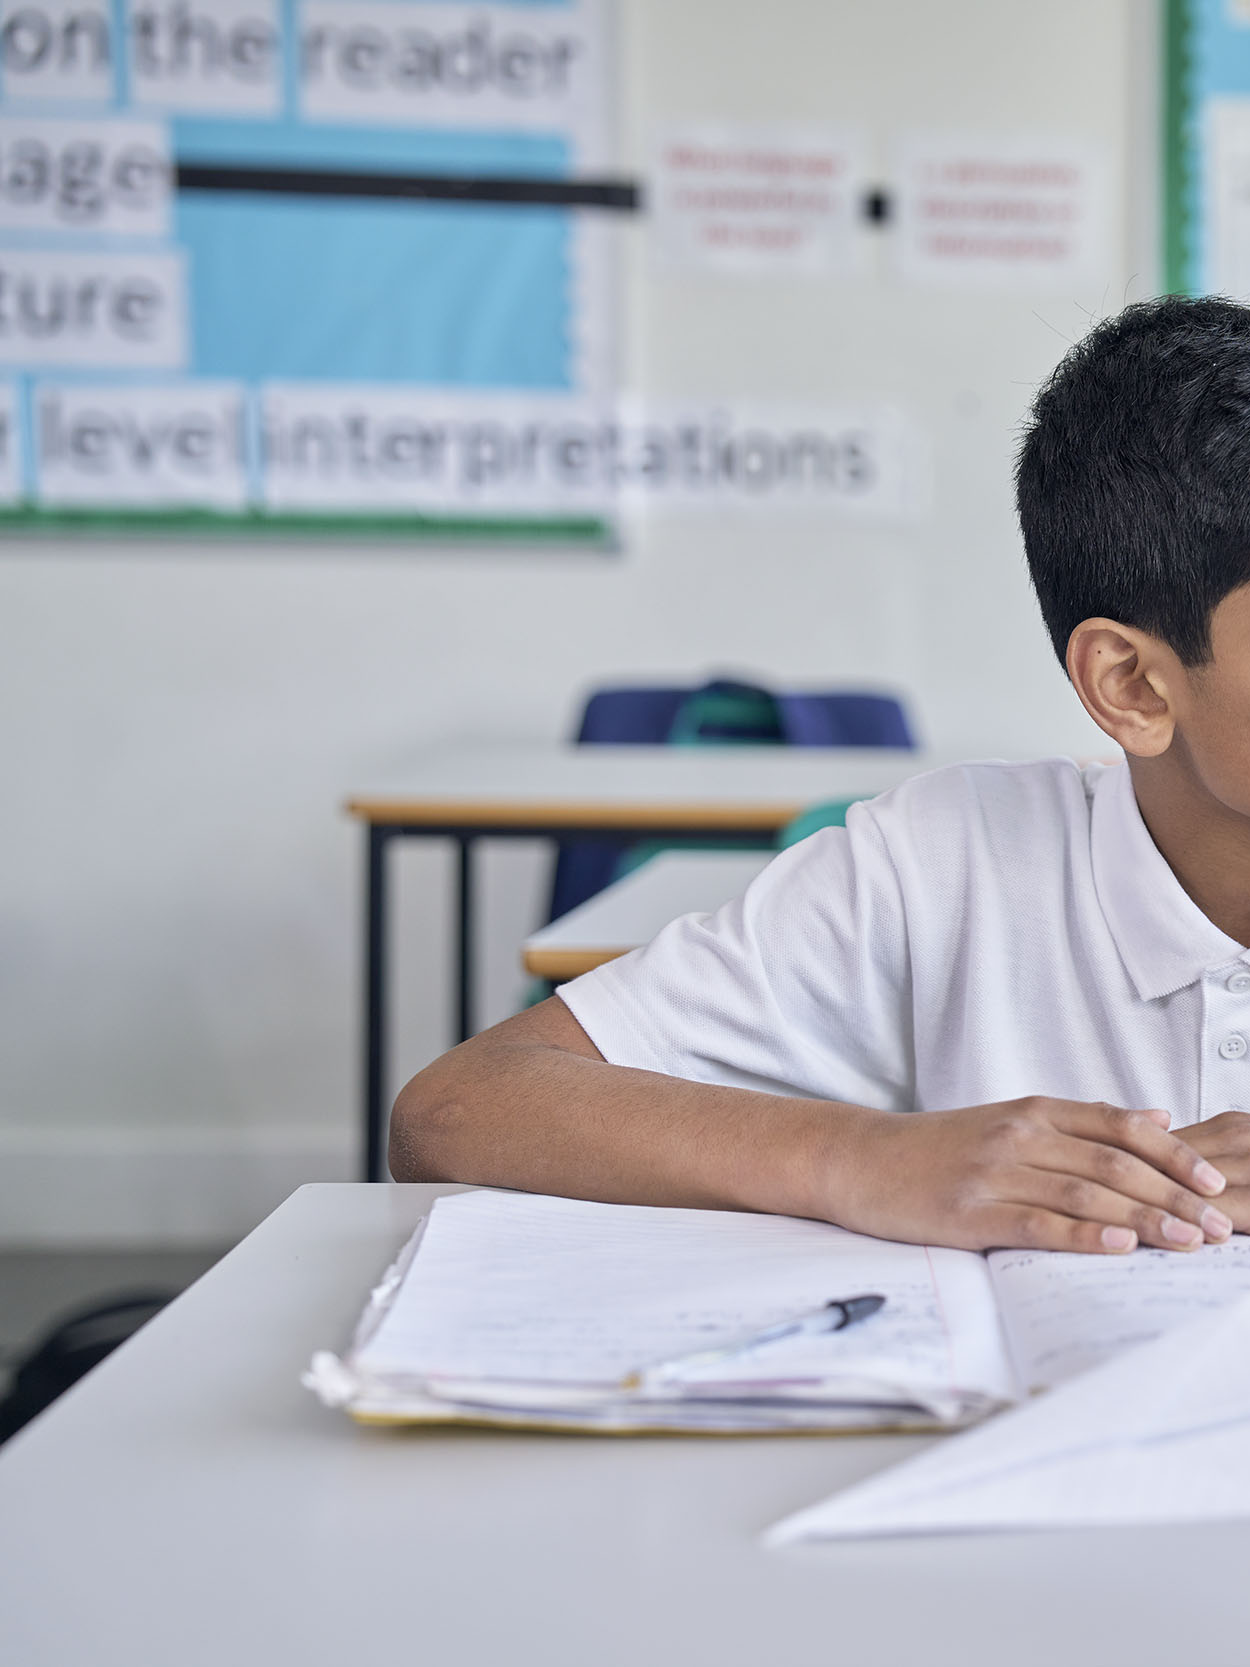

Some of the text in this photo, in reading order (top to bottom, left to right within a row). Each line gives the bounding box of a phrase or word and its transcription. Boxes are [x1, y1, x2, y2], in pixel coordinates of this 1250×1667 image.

[1, 3, 580, 97] on the reader
[38, 394, 247, 477] level
[265, 398, 876, 490] interpretations
